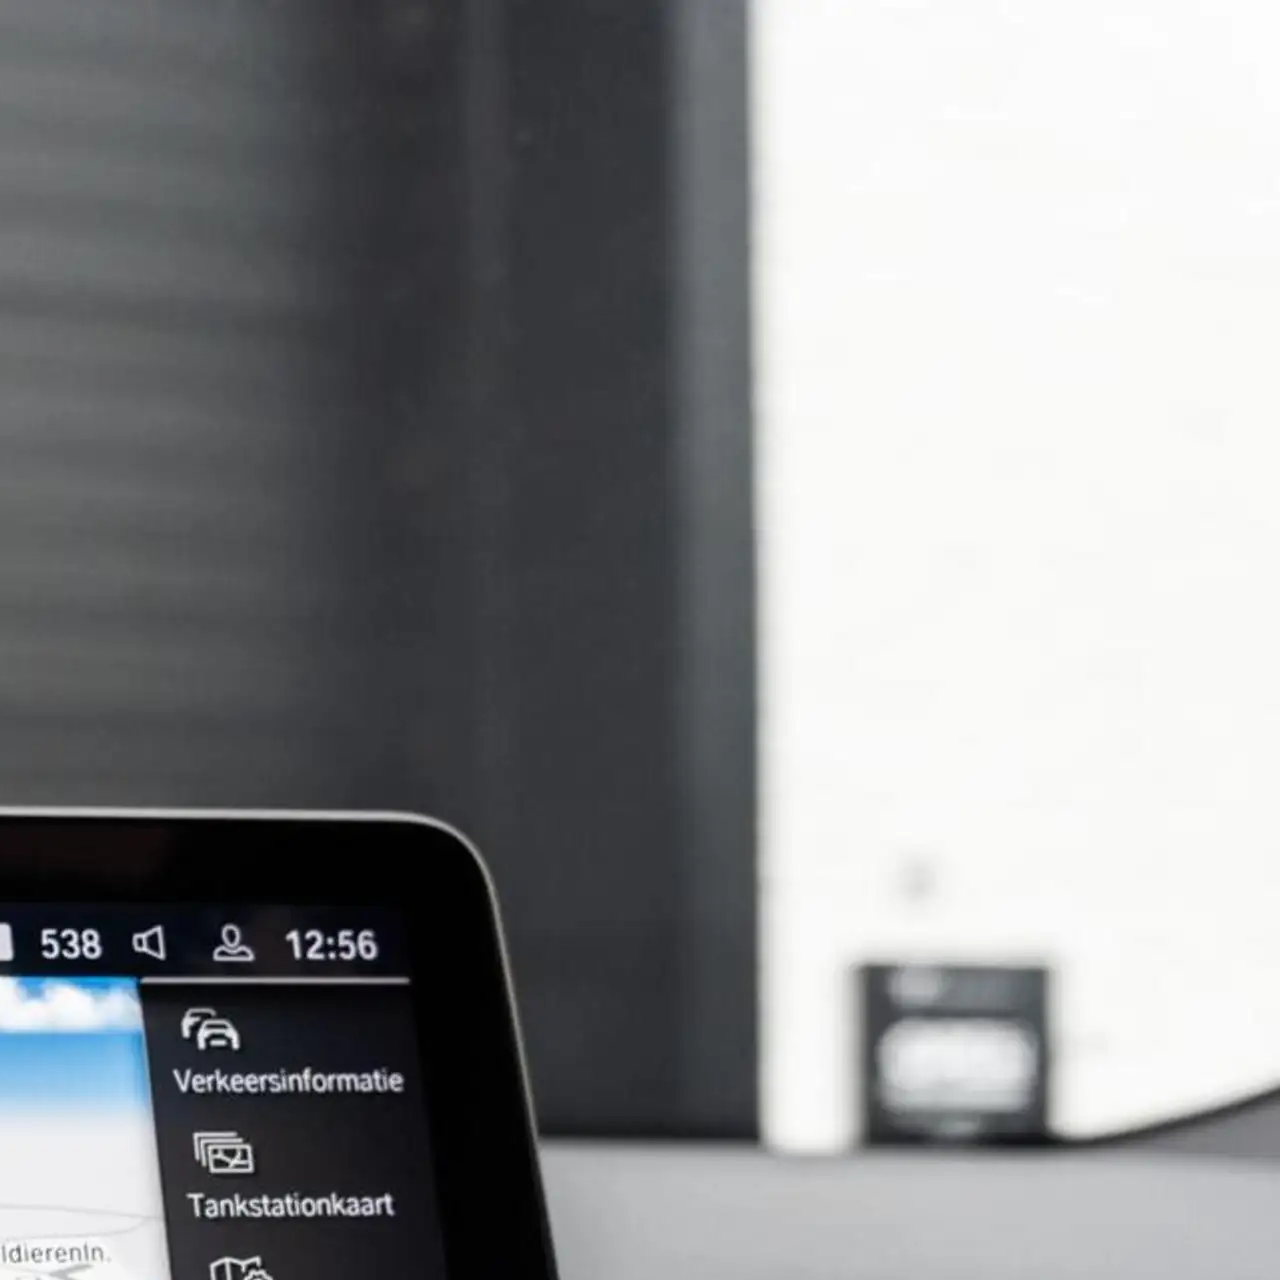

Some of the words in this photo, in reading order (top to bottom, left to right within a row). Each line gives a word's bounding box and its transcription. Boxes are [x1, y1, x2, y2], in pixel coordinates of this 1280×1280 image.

[40, 929, 102, 959] 538
[286, 929, 378, 961] 12:56
[173, 1068, 404, 1094] Verkeersinformatie
[187, 1191, 395, 1218] Tankstationkaart
